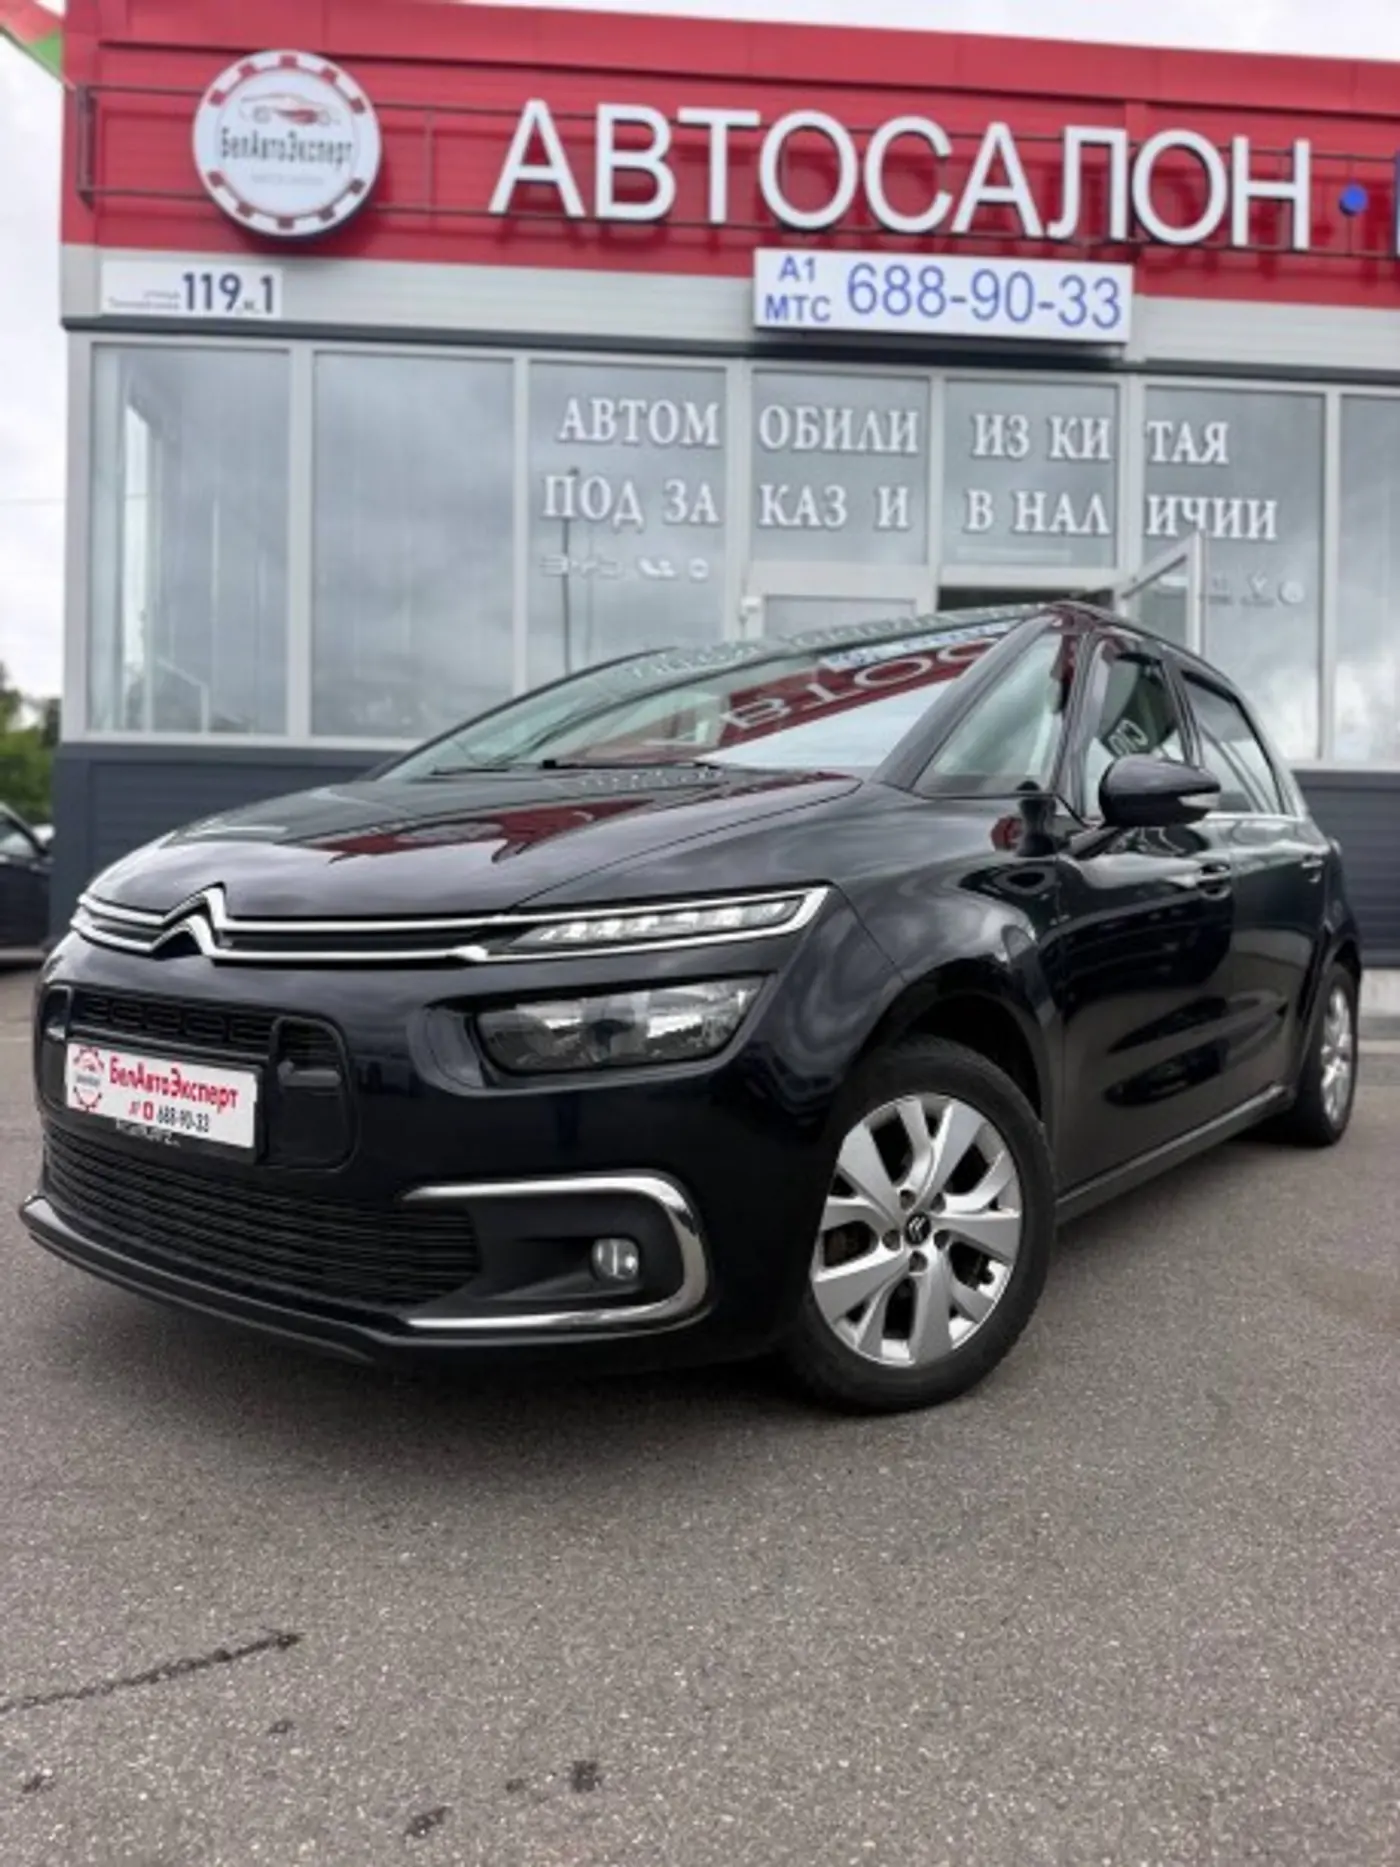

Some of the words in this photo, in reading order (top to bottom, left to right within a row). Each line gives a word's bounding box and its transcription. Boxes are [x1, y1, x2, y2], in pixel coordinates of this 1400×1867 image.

[488, 98, 1312, 251] АВТОСАЛОН
[764, 294, 832, 323] МТС
[846, 262, 1122, 330] 688-90-33
[972, 413, 1031, 459] ИЗ
[542, 474, 645, 530] ПОД
[874, 486, 910, 530] И
[966, 489, 994, 533] В
[109, 1055, 240, 1115] БелАвтоЭксперт
